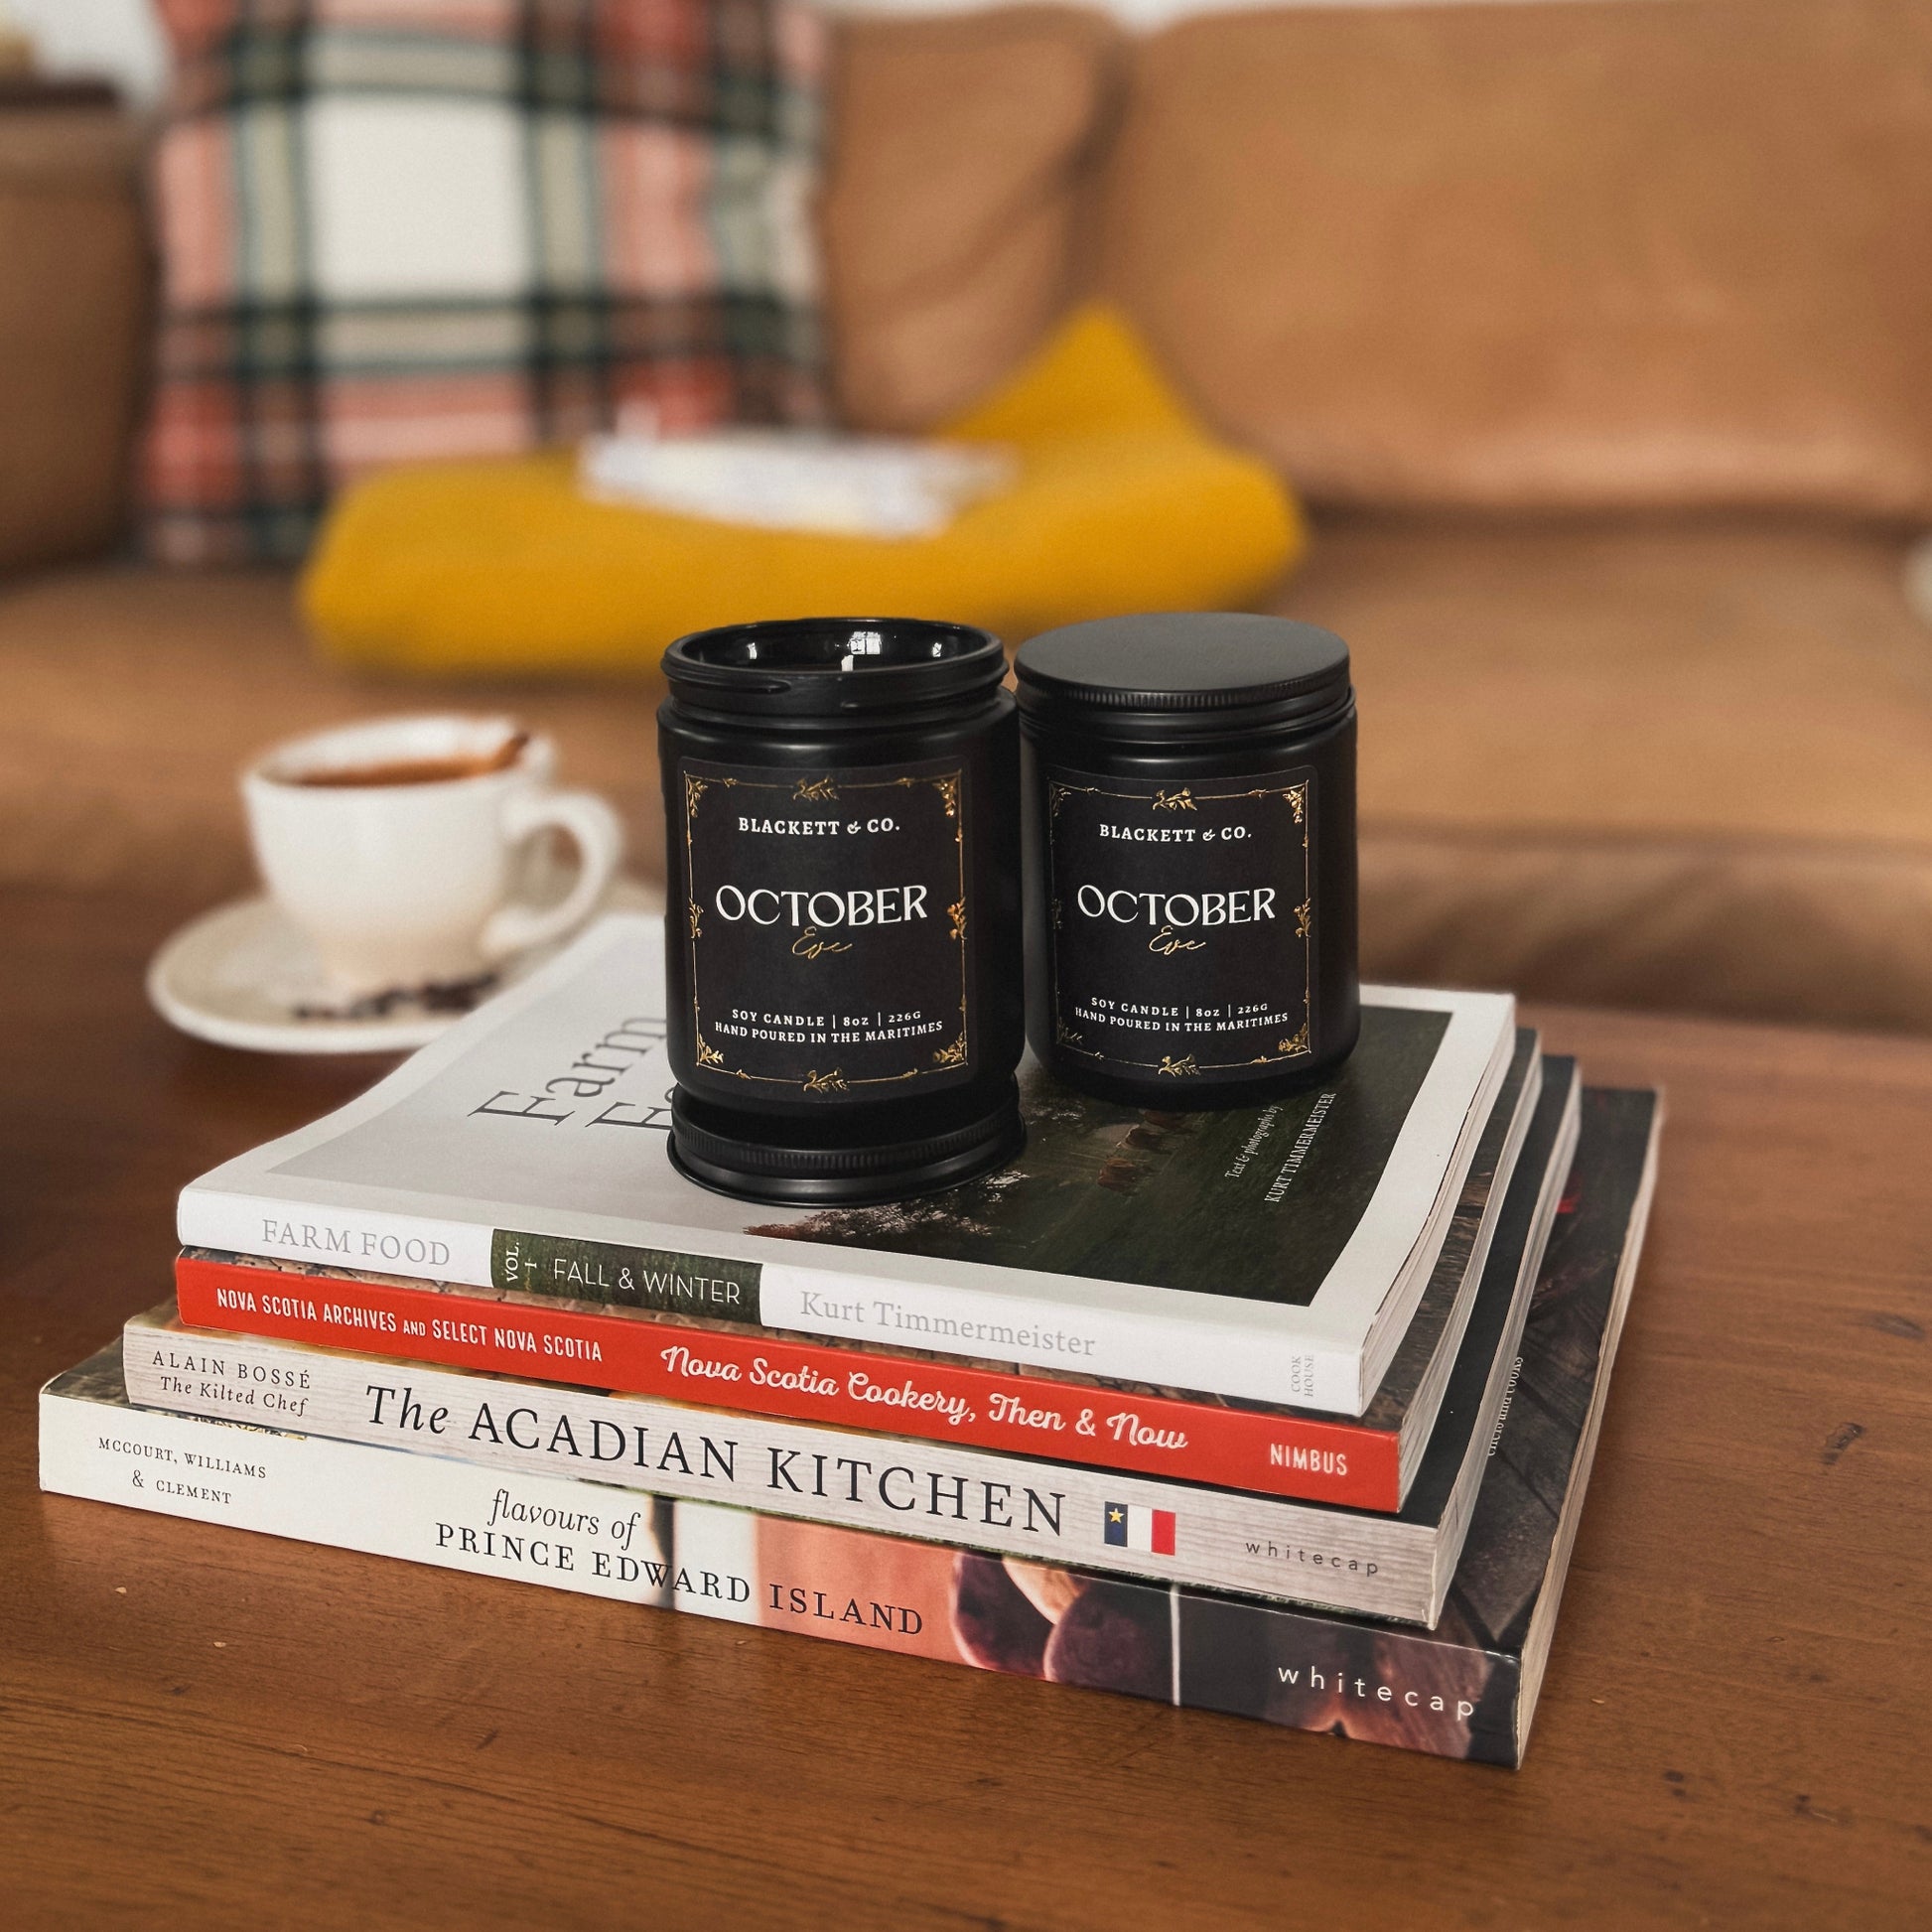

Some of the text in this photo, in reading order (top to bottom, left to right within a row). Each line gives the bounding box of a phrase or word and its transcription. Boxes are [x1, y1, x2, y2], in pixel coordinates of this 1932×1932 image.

[738, 817, 900, 835] BLACKETT & CO.
[1099, 824, 1252, 842] BLACKETT & CO.
[715, 885, 928, 927] OCTOBER
[1077, 885, 1276, 927] OCTOBER
[732, 1009, 758, 1023] SOY
[763, 1013, 825, 1027] CANDLE
[1075, 1007, 1289, 1033] HAND POURED IN THE MARITIMES
[1091, 997, 1116, 1010] SOY
[1121, 1003, 1179, 1017] CANDLE
[715, 1021, 943, 1042] HAND POURED IN THE MARITIMES
[468, 1017, 667, 1126] Farm
[1264, 1092, 1337, 1202] KURT TIMMERMEISTER
[262, 1218, 450, 1266] FARM FOOD
[505, 1241, 520, 1283] VOL.
[553, 1258, 741, 1305] FALL & WINTER
[216, 1288, 603, 1363] NOVA SCOTIA ARCHIVES AND SELECT NOVA SCOTIA
[800, 1291, 1096, 1357] Kurt Timmermeister
[152, 1350, 311, 1390] ALAIN BOSSÉ
[1291, 1355, 1302, 1393] COOK
[1304, 1354, 1313, 1397] HOUSE
[160, 1376, 310, 1418] The Kilted Chef
[660, 1345, 1188, 1449] Nova Scotia Cookery, Then & Now
[98, 1437, 267, 1479] MCCOURT, WILLIAMS
[366, 1385, 1066, 1537] The ACADIAN KITCHEN
[1270, 1443, 1347, 1476] NIMBUS
[132, 1469, 232, 1505] & CLEMENT
[486, 1488, 640, 1551] flavours of
[435, 1522, 923, 1636] PRINCE EDWARD ISLAND
[1245, 1540, 1378, 1578] whitecap
[1278, 1666, 1475, 1722] whitecap
